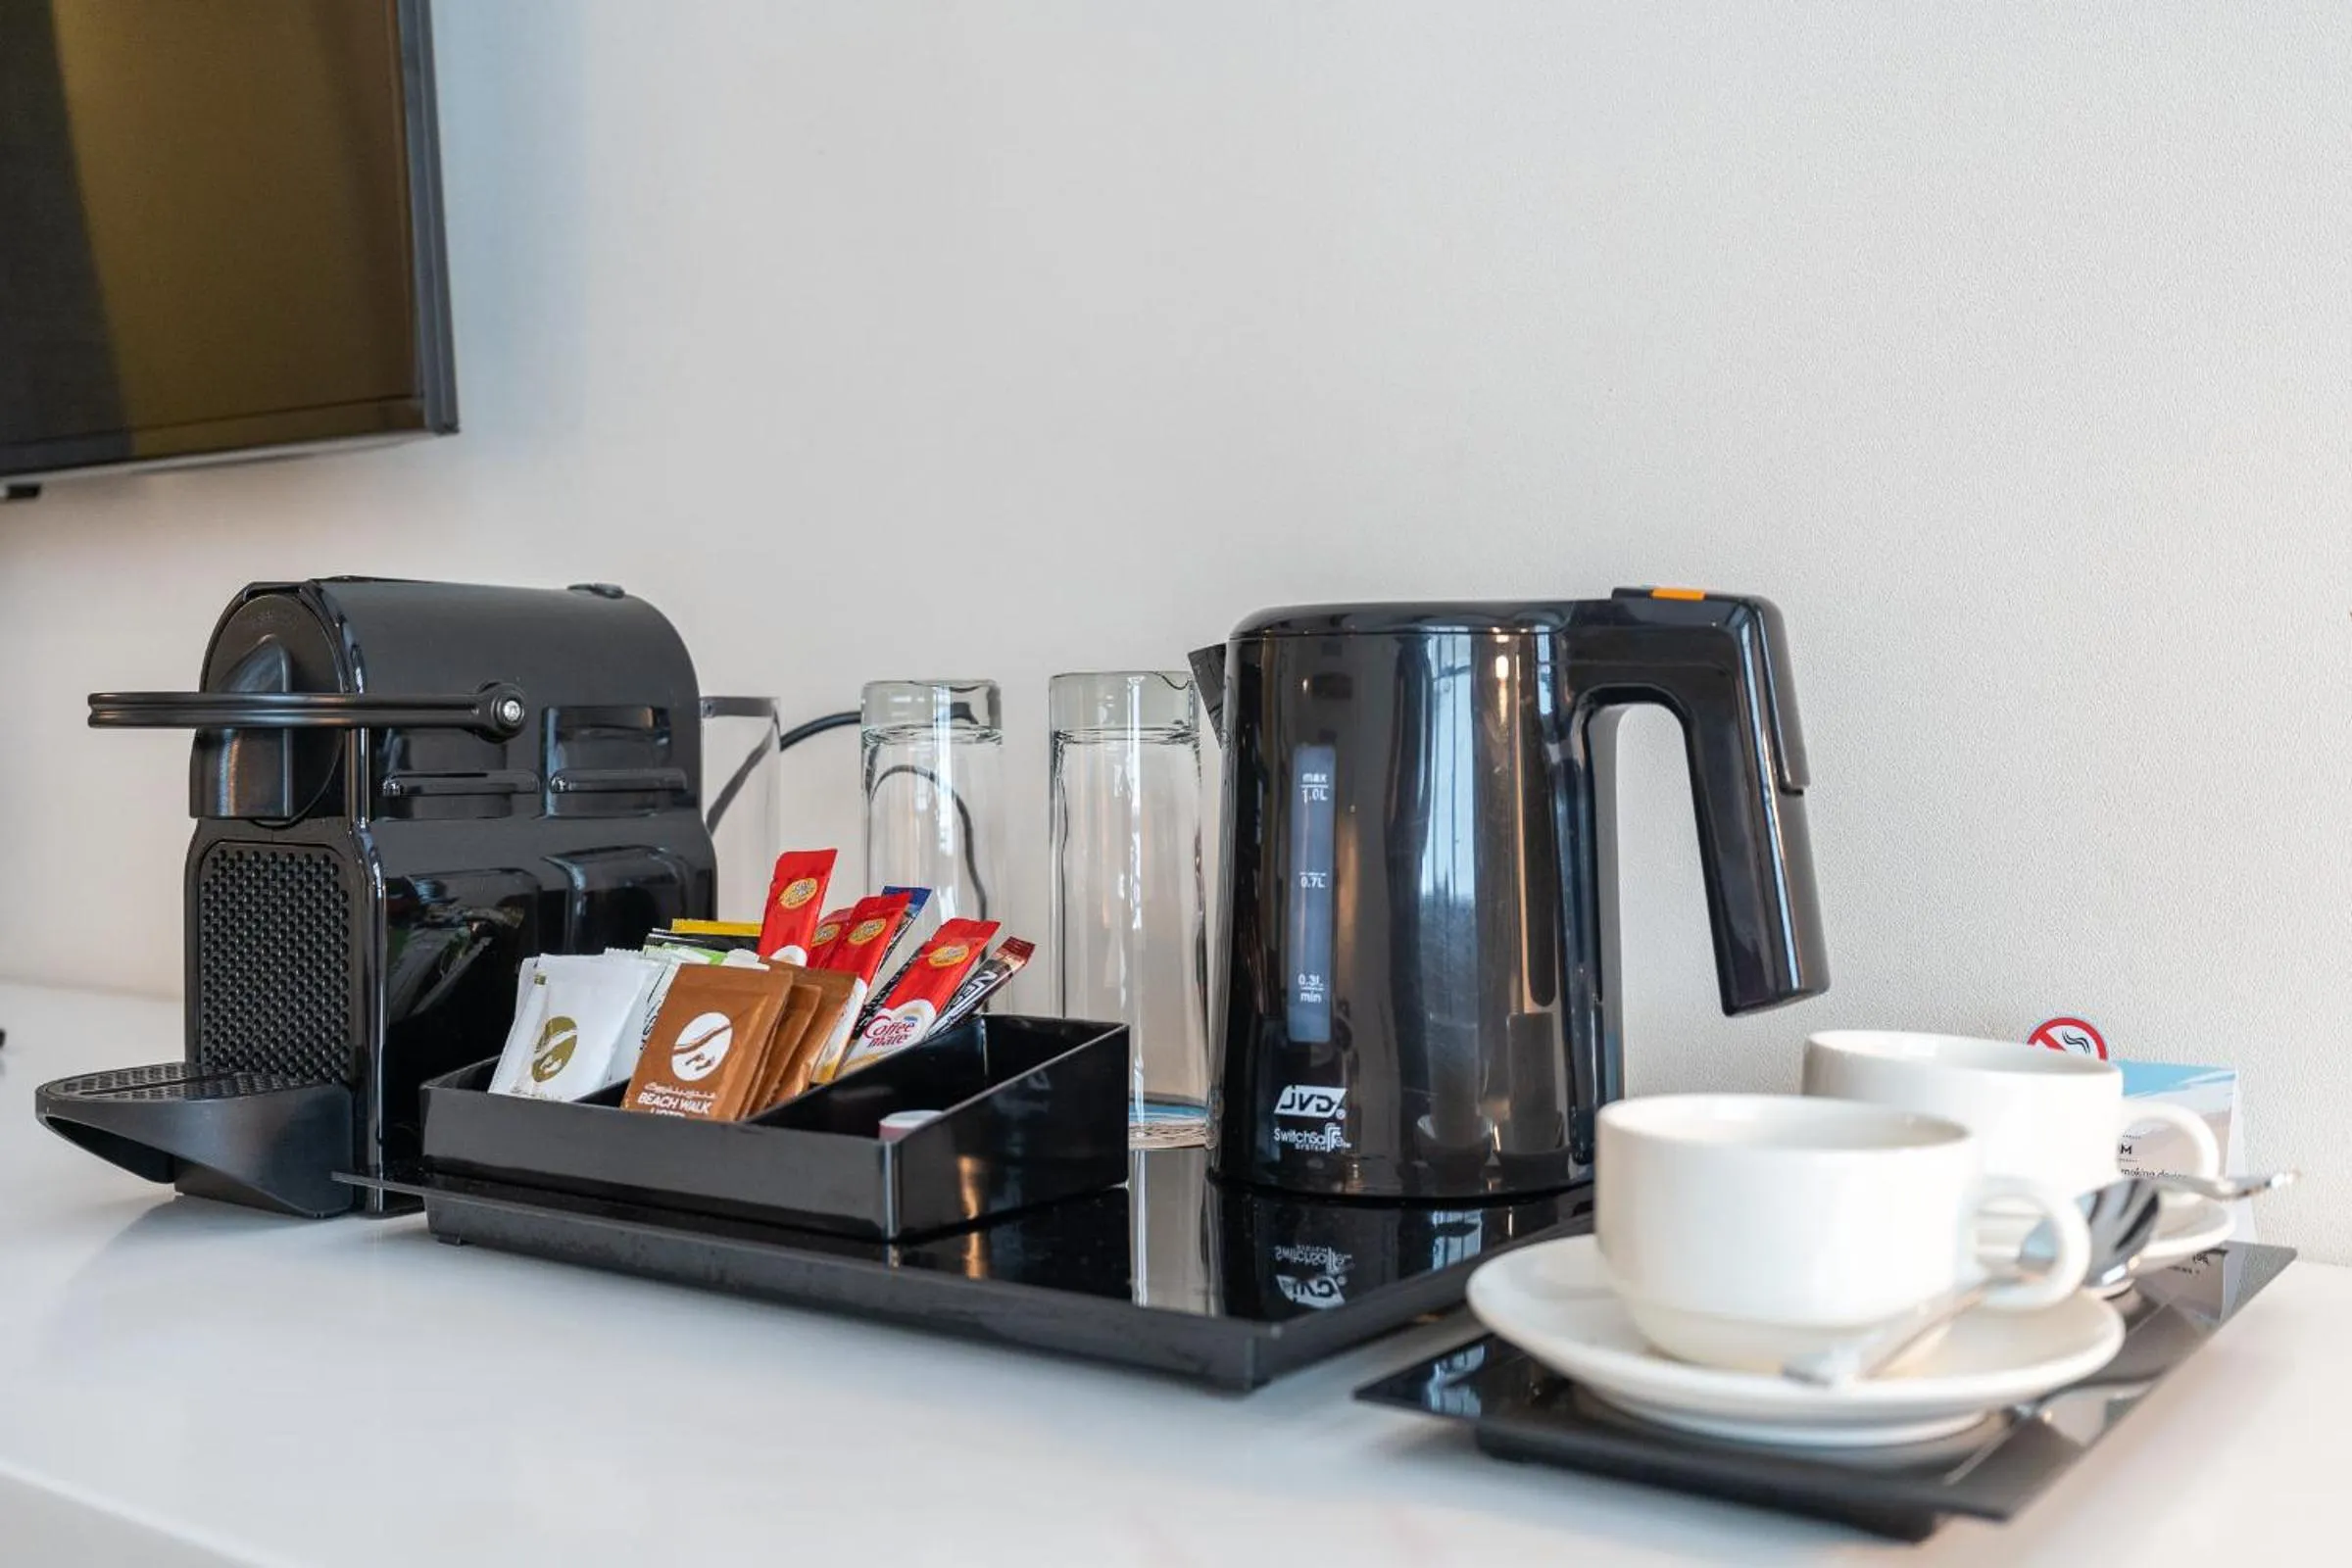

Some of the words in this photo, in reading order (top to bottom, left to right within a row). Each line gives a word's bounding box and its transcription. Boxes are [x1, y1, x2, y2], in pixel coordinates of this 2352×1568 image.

[1302, 773, 1327, 783] max
[1302, 788, 1328, 802] 1.0L
[1300, 876, 1325, 888] 0.7L
[1300, 991, 1322, 1004] min
[863, 1015, 915, 1039] Coffee
[867, 1033, 909, 1048] mate
[637, 1092, 677, 1109] BEACH
[680, 1098, 712, 1114] WALK
[1278, 1084, 1339, 1114] JVD
